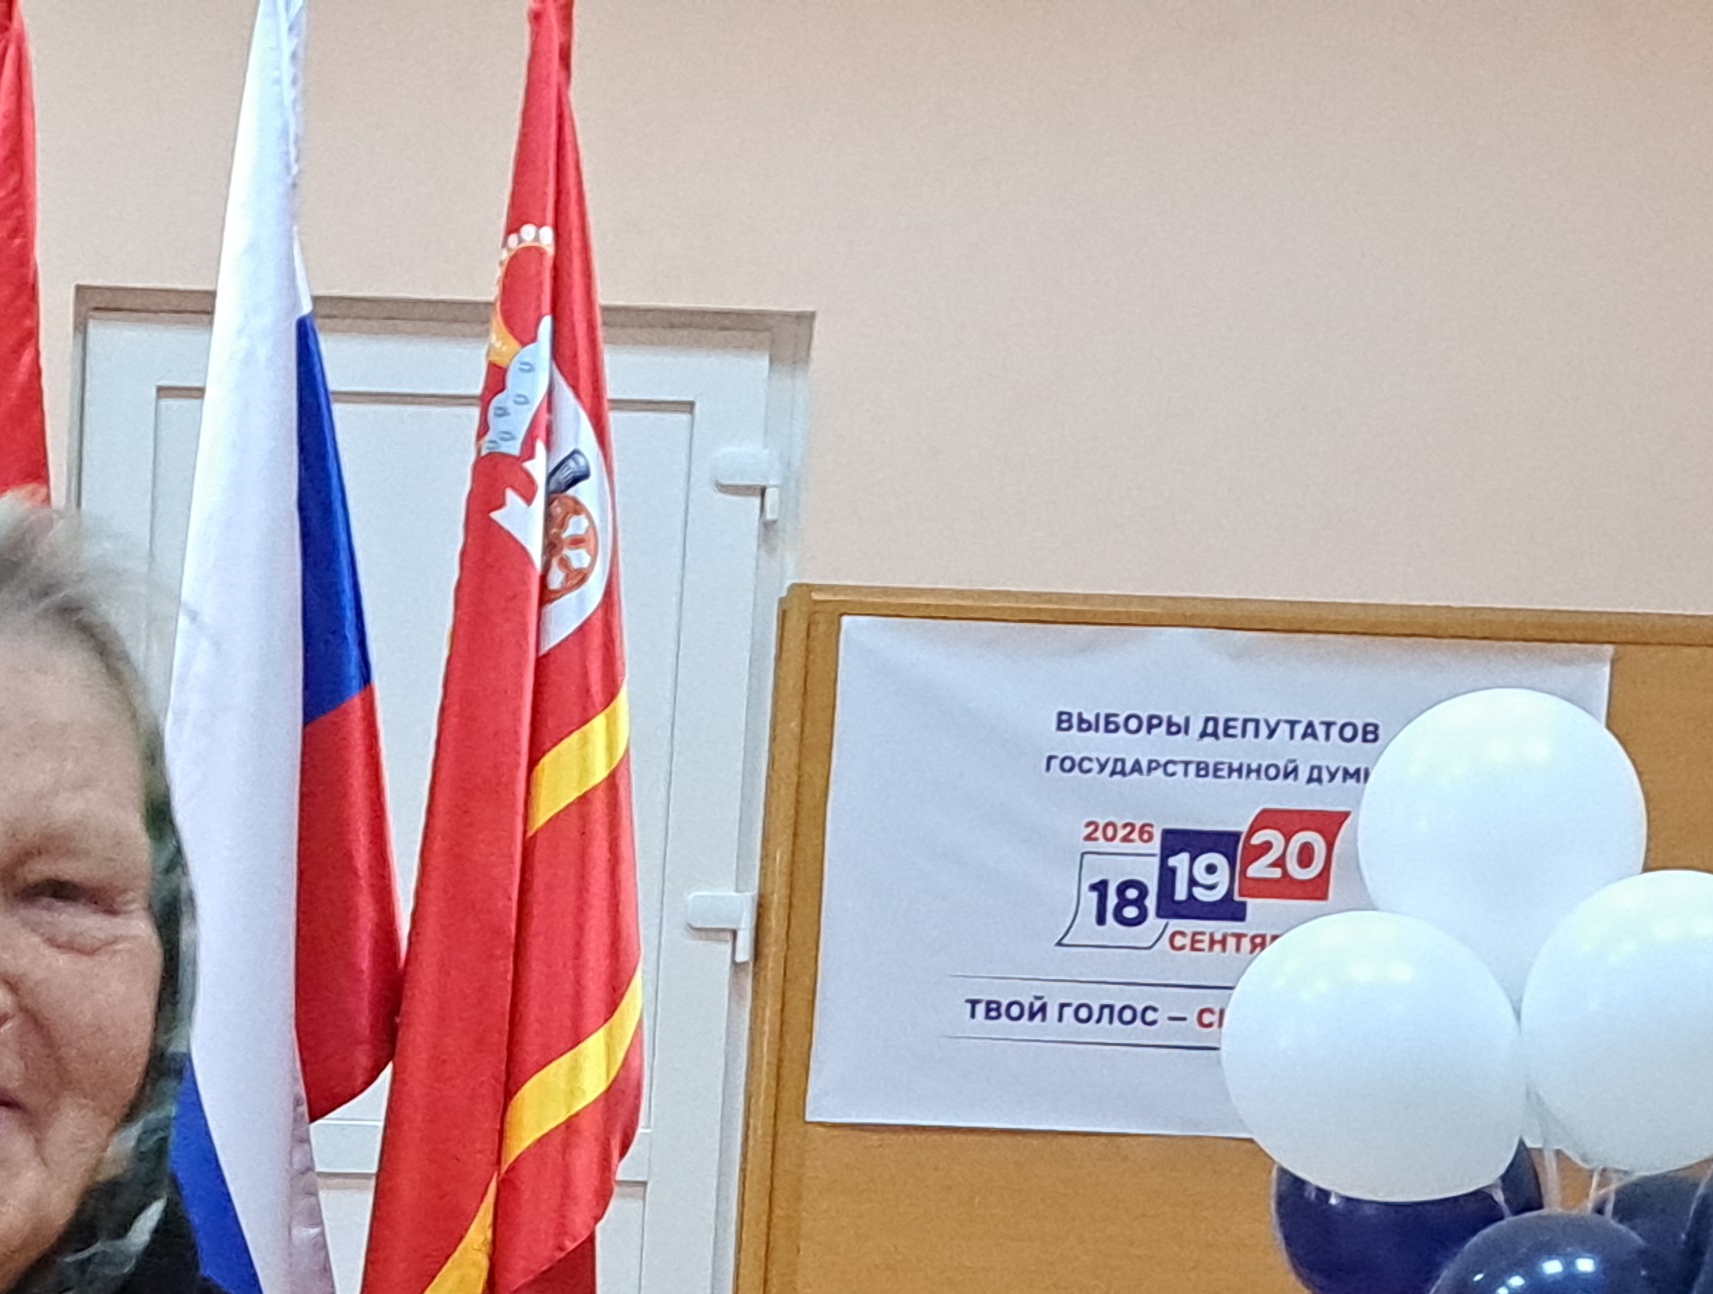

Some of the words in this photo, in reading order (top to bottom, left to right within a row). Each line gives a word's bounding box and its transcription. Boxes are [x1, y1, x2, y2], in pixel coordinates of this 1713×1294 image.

[1055, 711, 1190, 736] ВЫБОРЫ
[1198, 716, 1380, 744] ДЕПУТАТОВ
[1045, 755, 1299, 782] ГОСУДАРСТВЕННОЙ
[1083, 820, 1154, 843] 2026
[1088, 878, 1149, 927] 18
[1167, 852, 1230, 902] 19
[1246, 829, 1327, 880] 20
[1169, 930, 1282, 954] СЕНТЯ
[965, 995, 1047, 1022] ТВОЙ
[1057, 1002, 1159, 1026] ГОЛОС
